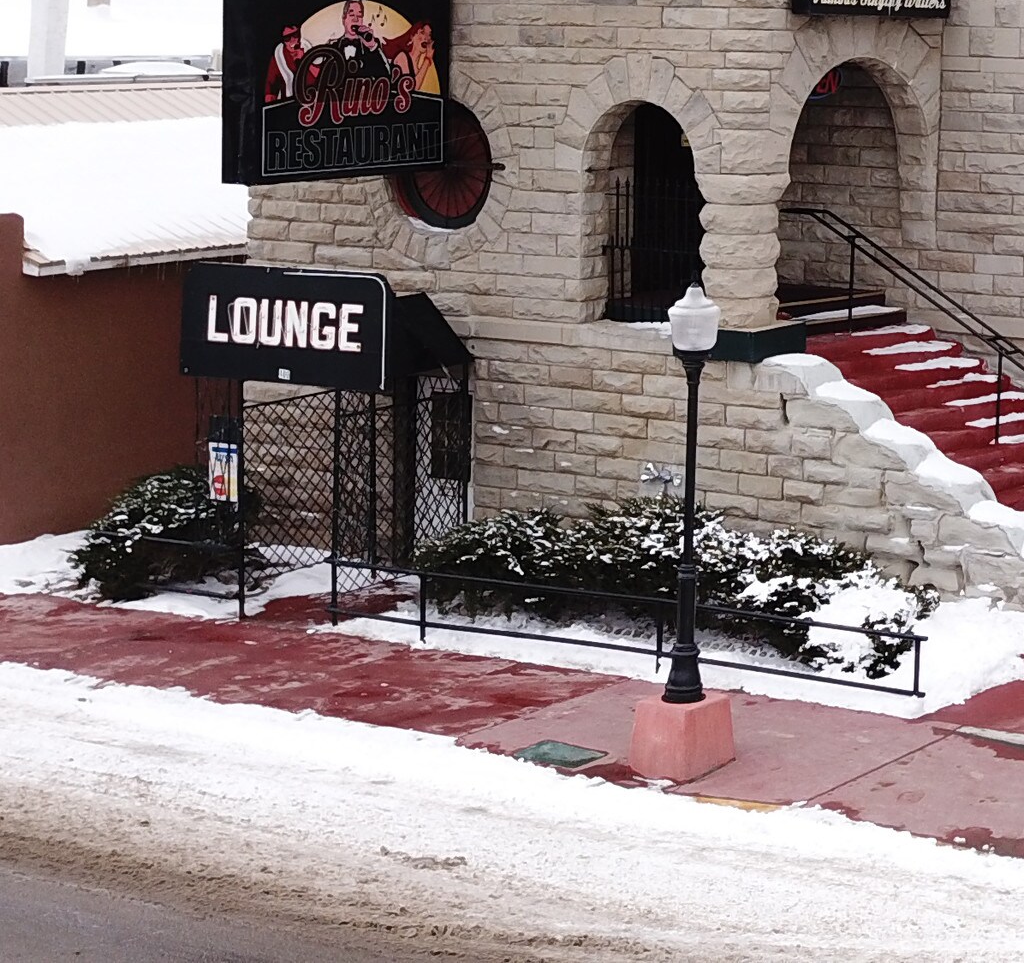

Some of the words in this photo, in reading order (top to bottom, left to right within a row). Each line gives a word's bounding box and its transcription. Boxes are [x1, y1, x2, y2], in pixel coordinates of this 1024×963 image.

[294, 47, 415, 127] Rino's
[267, 122, 440, 171] RESTAURANT
[207, 294, 364, 352] LOUNGE
